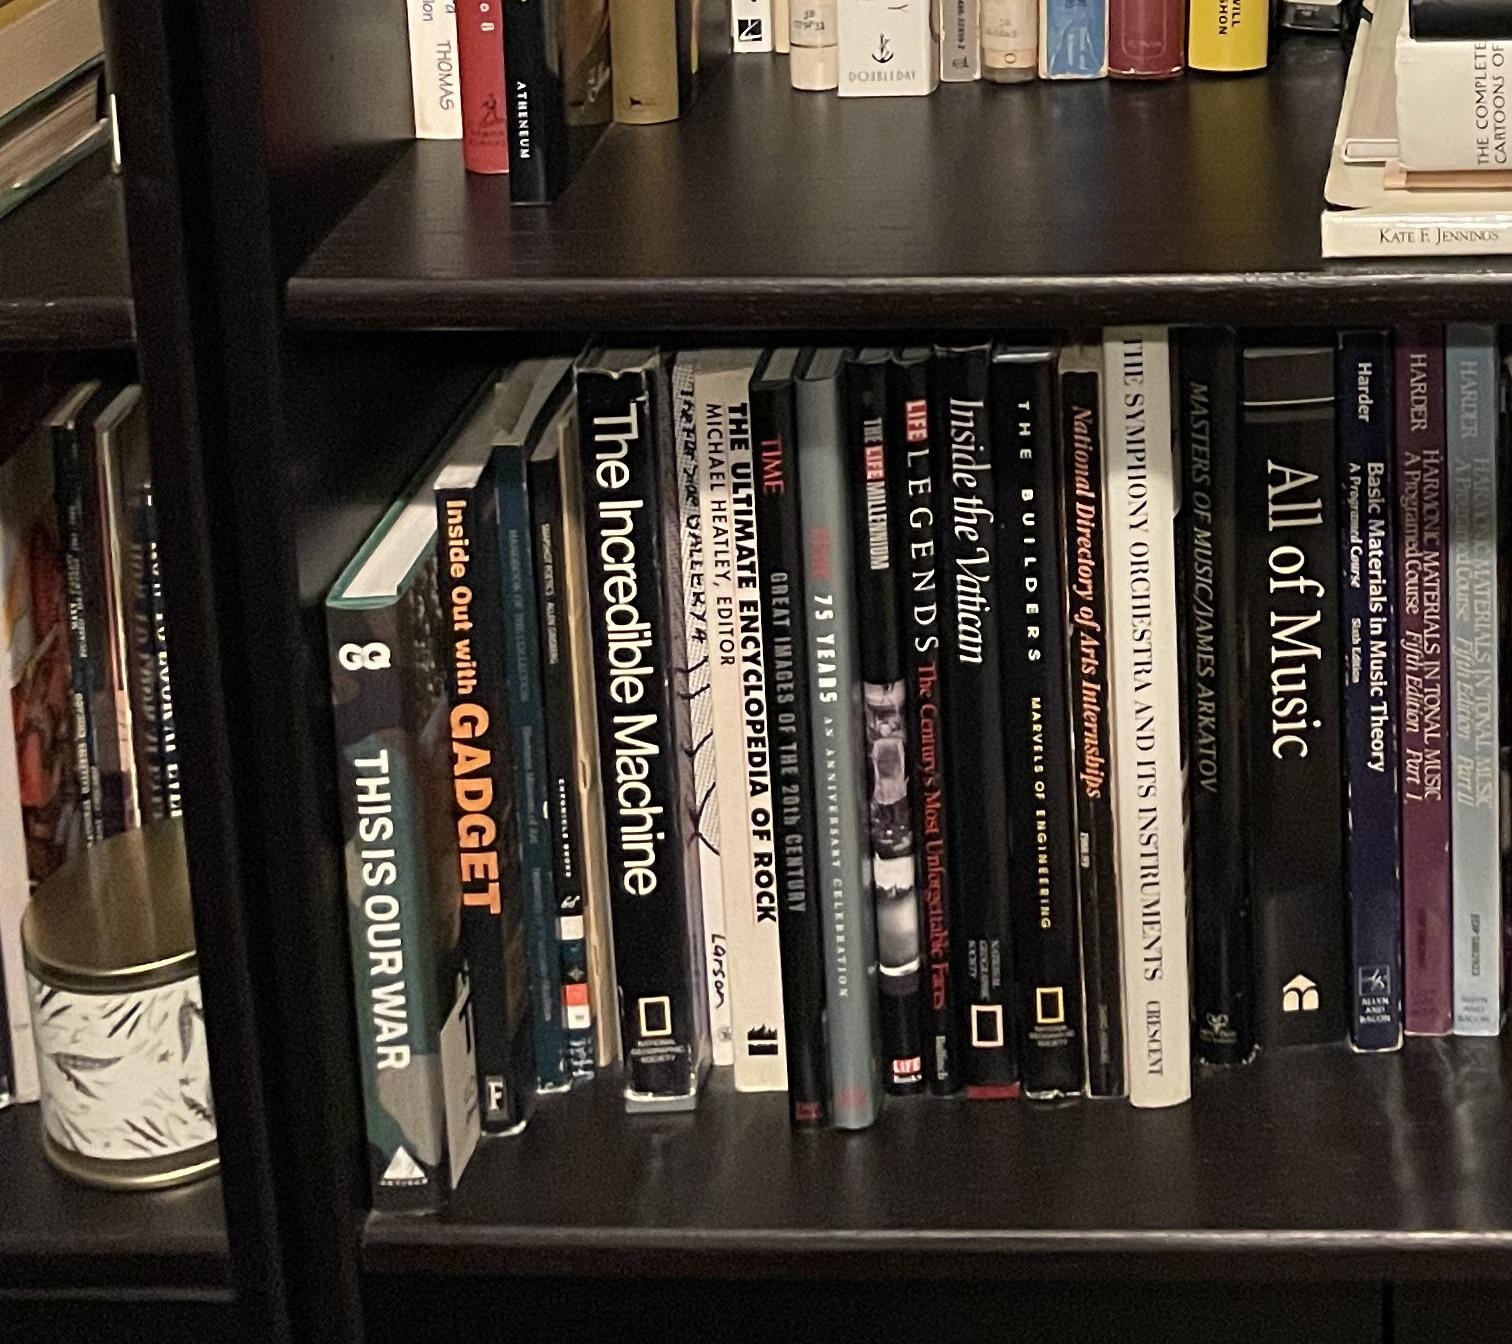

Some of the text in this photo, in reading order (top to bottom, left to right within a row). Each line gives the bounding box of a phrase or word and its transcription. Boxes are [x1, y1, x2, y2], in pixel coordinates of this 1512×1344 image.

[516, 81, 529, 159] ATHENEUM
[905, 399, 928, 442] LIFE
[1357, 362, 1373, 423] Harder
[1409, 353, 1428, 431] HARDER
[907, 448, 939, 652] LEGENDS
[949, 397, 994, 664] Inside the Vatican
[1267, 459, 1325, 759] All of Music
[593, 402, 668, 897] The Incredible Machine
[727, 402, 777, 923] THE ULTIMATE ENCYCLOPEDIA OF ROCK
[353, 749, 411, 1070] THIS IS OUR WAR
[450, 703, 501, 915] GADGET
